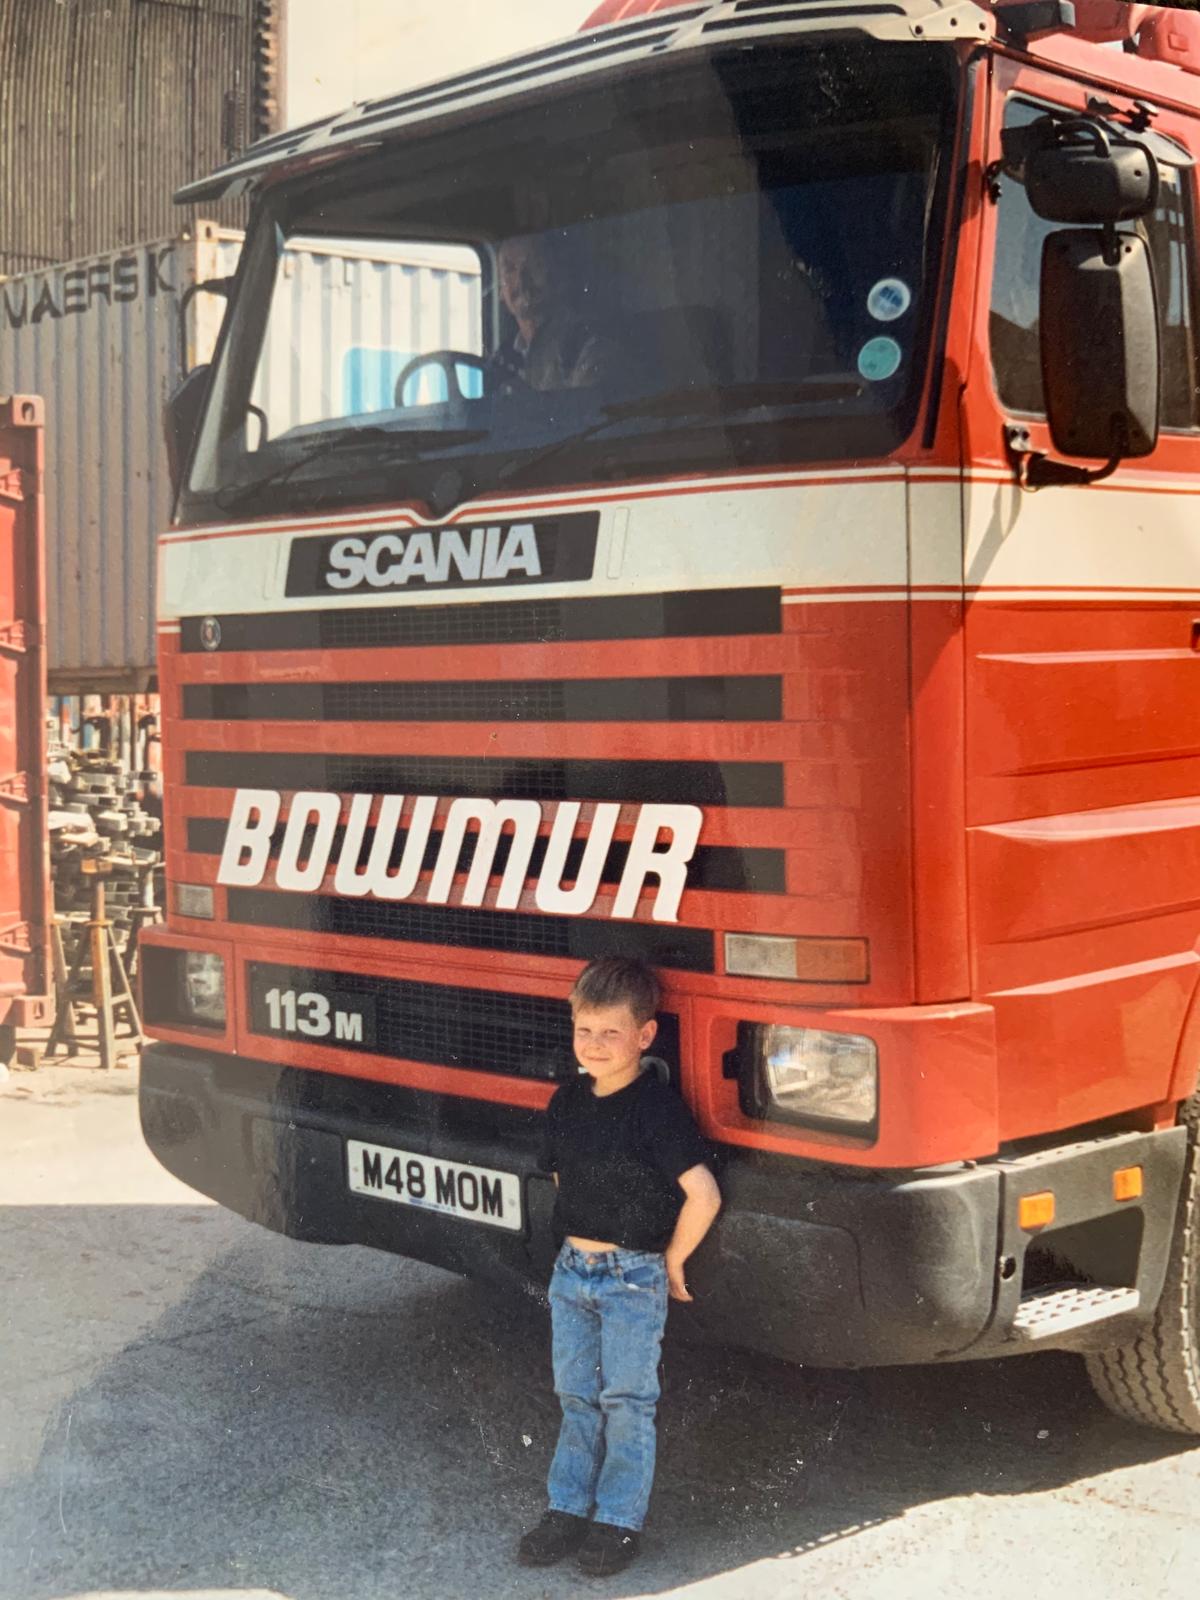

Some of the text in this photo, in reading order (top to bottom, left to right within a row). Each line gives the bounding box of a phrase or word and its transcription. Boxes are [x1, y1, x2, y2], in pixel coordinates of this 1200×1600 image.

[2, 246, 176, 329] MAERSK
[325, 523, 542, 589] SCANIA
[216, 788, 704, 922] BOWMUR
[265, 988, 362, 1041] 113 M
[362, 1149, 504, 1217] M48 MOM
